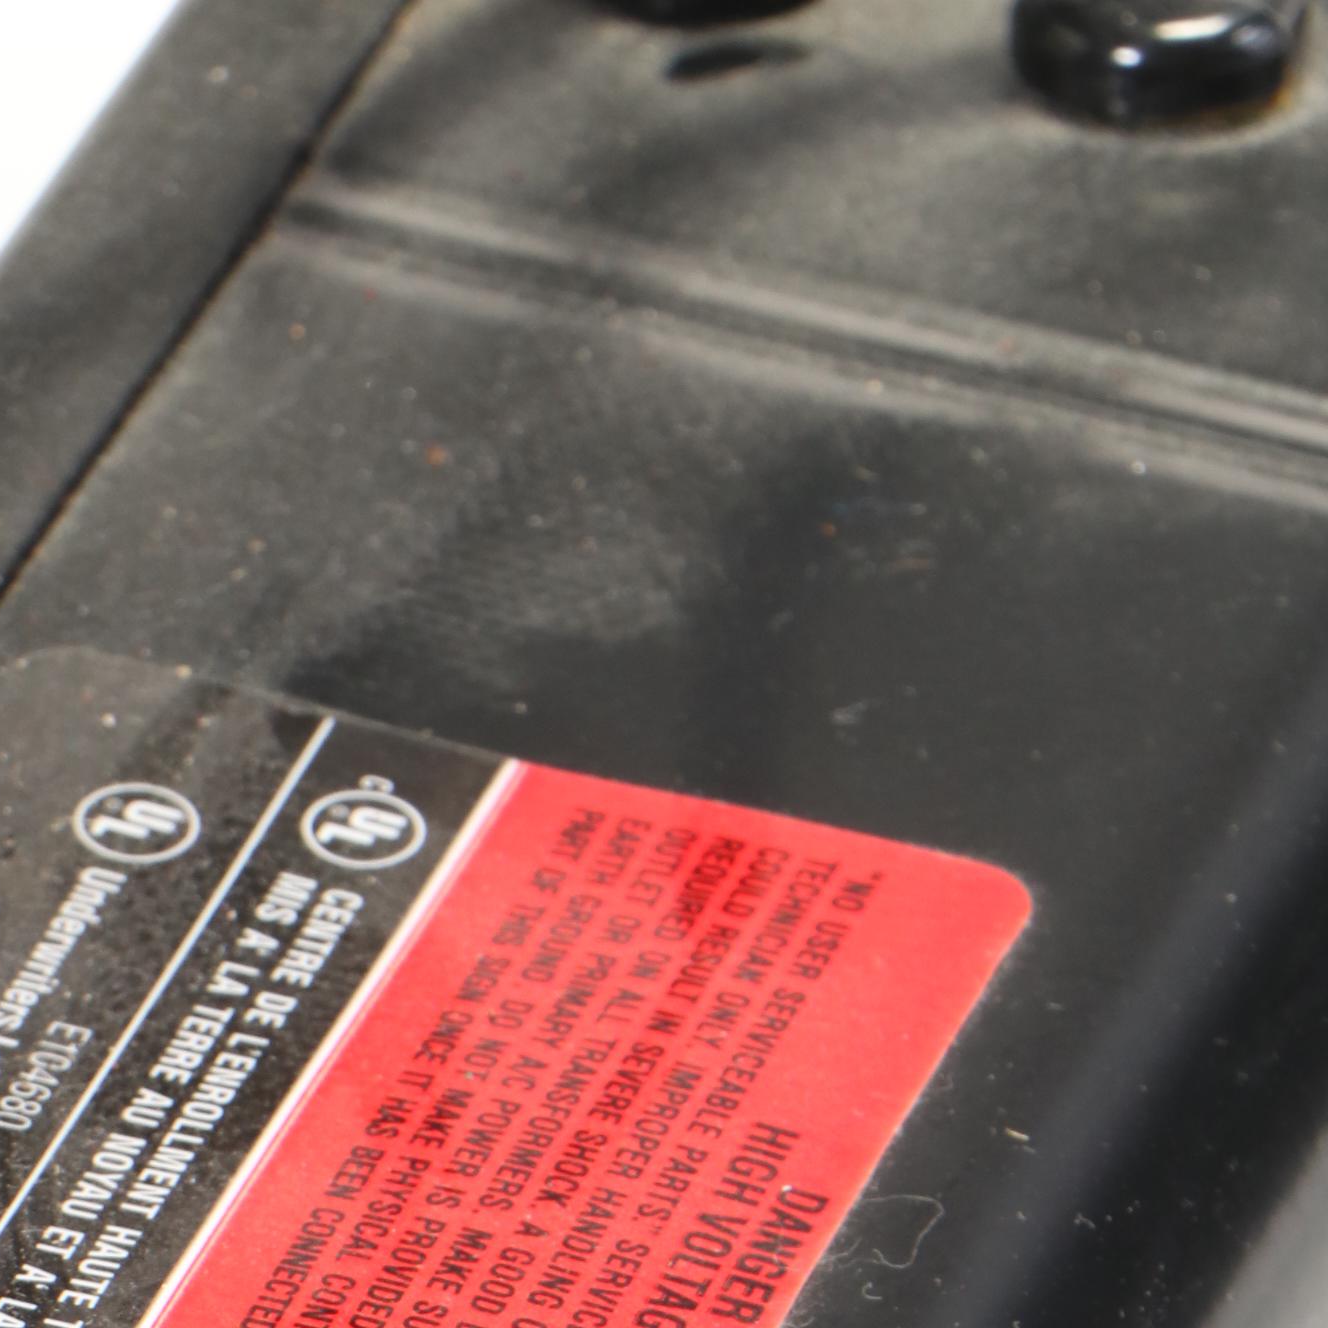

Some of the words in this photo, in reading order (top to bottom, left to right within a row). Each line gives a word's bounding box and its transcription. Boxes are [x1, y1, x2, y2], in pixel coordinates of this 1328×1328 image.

[553, 809, 605, 861] PART
[587, 818, 651, 886] EARTH
[626, 827, 698, 907] OUTLET
[252, 871, 319, 925] MIS
[528, 867, 566, 894] OF
[652, 836, 745, 941] REQUIRED
[719, 846, 790, 918] COULD
[268, 887, 366, 988] CENTRE
[490, 904, 545, 947] THIS
[600, 914, 641, 944] OR
[732, 859, 837, 984] TECHNICIAN
[790, 920, 846, 980] USER
[204, 960, 261, 997] LA
[454, 954, 511, 1003] SIGN
[628, 951, 670, 980] ON
[666, 924, 740, 1004] RESULT
[241, 990, 298, 1029] DE
[486, 998, 534, 1030] DO
[535, 953, 616, 1049] PRIMARY
[595, 987, 645, 1025] ALL
[646, 1011, 682, 1034] IN
[147, 1002, 235, 1085] TERRE
[413, 1009, 474, 1065] ONCE
[457, 1037, 507, 1082] NOT
[686, 987, 806, 1137] SERVICEABLE
[396, 1070, 434, 1091] IT
[499, 1055, 548, 1091] A/C
[586, 1041, 665, 1124] SEVERE
[116, 1031, 270, 1220] L'ENROLLMENT
[118, 1086, 175, 1128] AU
[363, 1096, 414, 1138] HAS
[409, 1087, 474, 1149] MAKE
[443, 1098, 521, 1178] POWER
[470, 1037, 616, 1215] TRANSFORMERS.
[606, 1064, 704, 1179] IMPROPER
[57, 1132, 146, 1221] NOYAU
[323, 1145, 385, 1201] BEEN
[424, 1184, 465, 1209] IS
[528, 1129, 608, 1210] SHOCK.
[712, 1122, 800, 1206] HIGH
[334, 1155, 431, 1263] PHYSICAL
[514, 1220, 550, 1238] A
[32, 1224, 85, 1260] ET
[55, 1223, 142, 1309] HAUTE
[425, 1226, 494, 1294] MAKE
[525, 1187, 627, 1309] HANDLING
[708, 1187, 829, 1324] DANGER
[467, 1246, 536, 1315] GOOD
